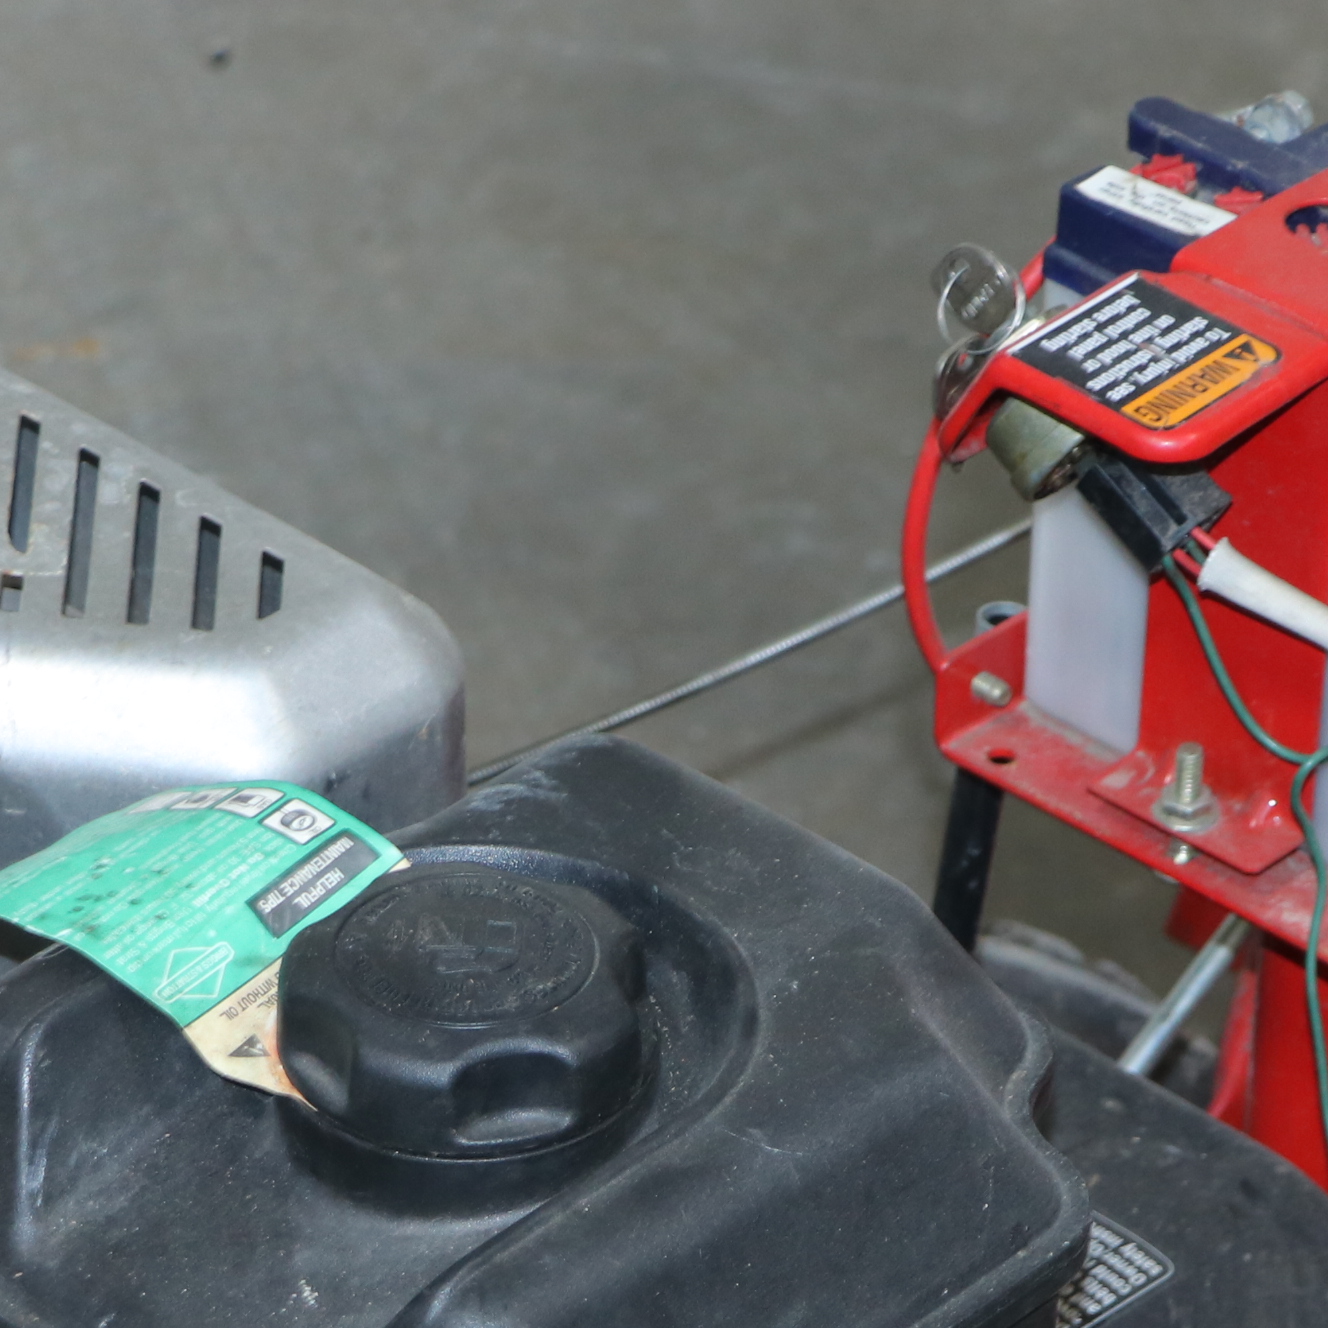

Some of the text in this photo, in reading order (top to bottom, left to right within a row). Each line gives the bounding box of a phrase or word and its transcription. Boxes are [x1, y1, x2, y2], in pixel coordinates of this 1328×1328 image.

[1038, 293, 1142, 353] before starting
[1066, 307, 1152, 362] control panel
[1152, 316, 1209, 350] starting
[1153, 314, 1176, 330] on
[1080, 358, 1102, 374] or
[1094, 338, 1138, 365] hood
[1105, 327, 1232, 403] To avoid injury, see
[1134, 360, 1240, 422] WARNING
[227, 862, 252, 879] Not
[255, 829, 354, 916] MAINTENANCE TIPS
[290, 864, 345, 913] HELPFUL
[218, 974, 277, 1026] WITHOUT OIL
